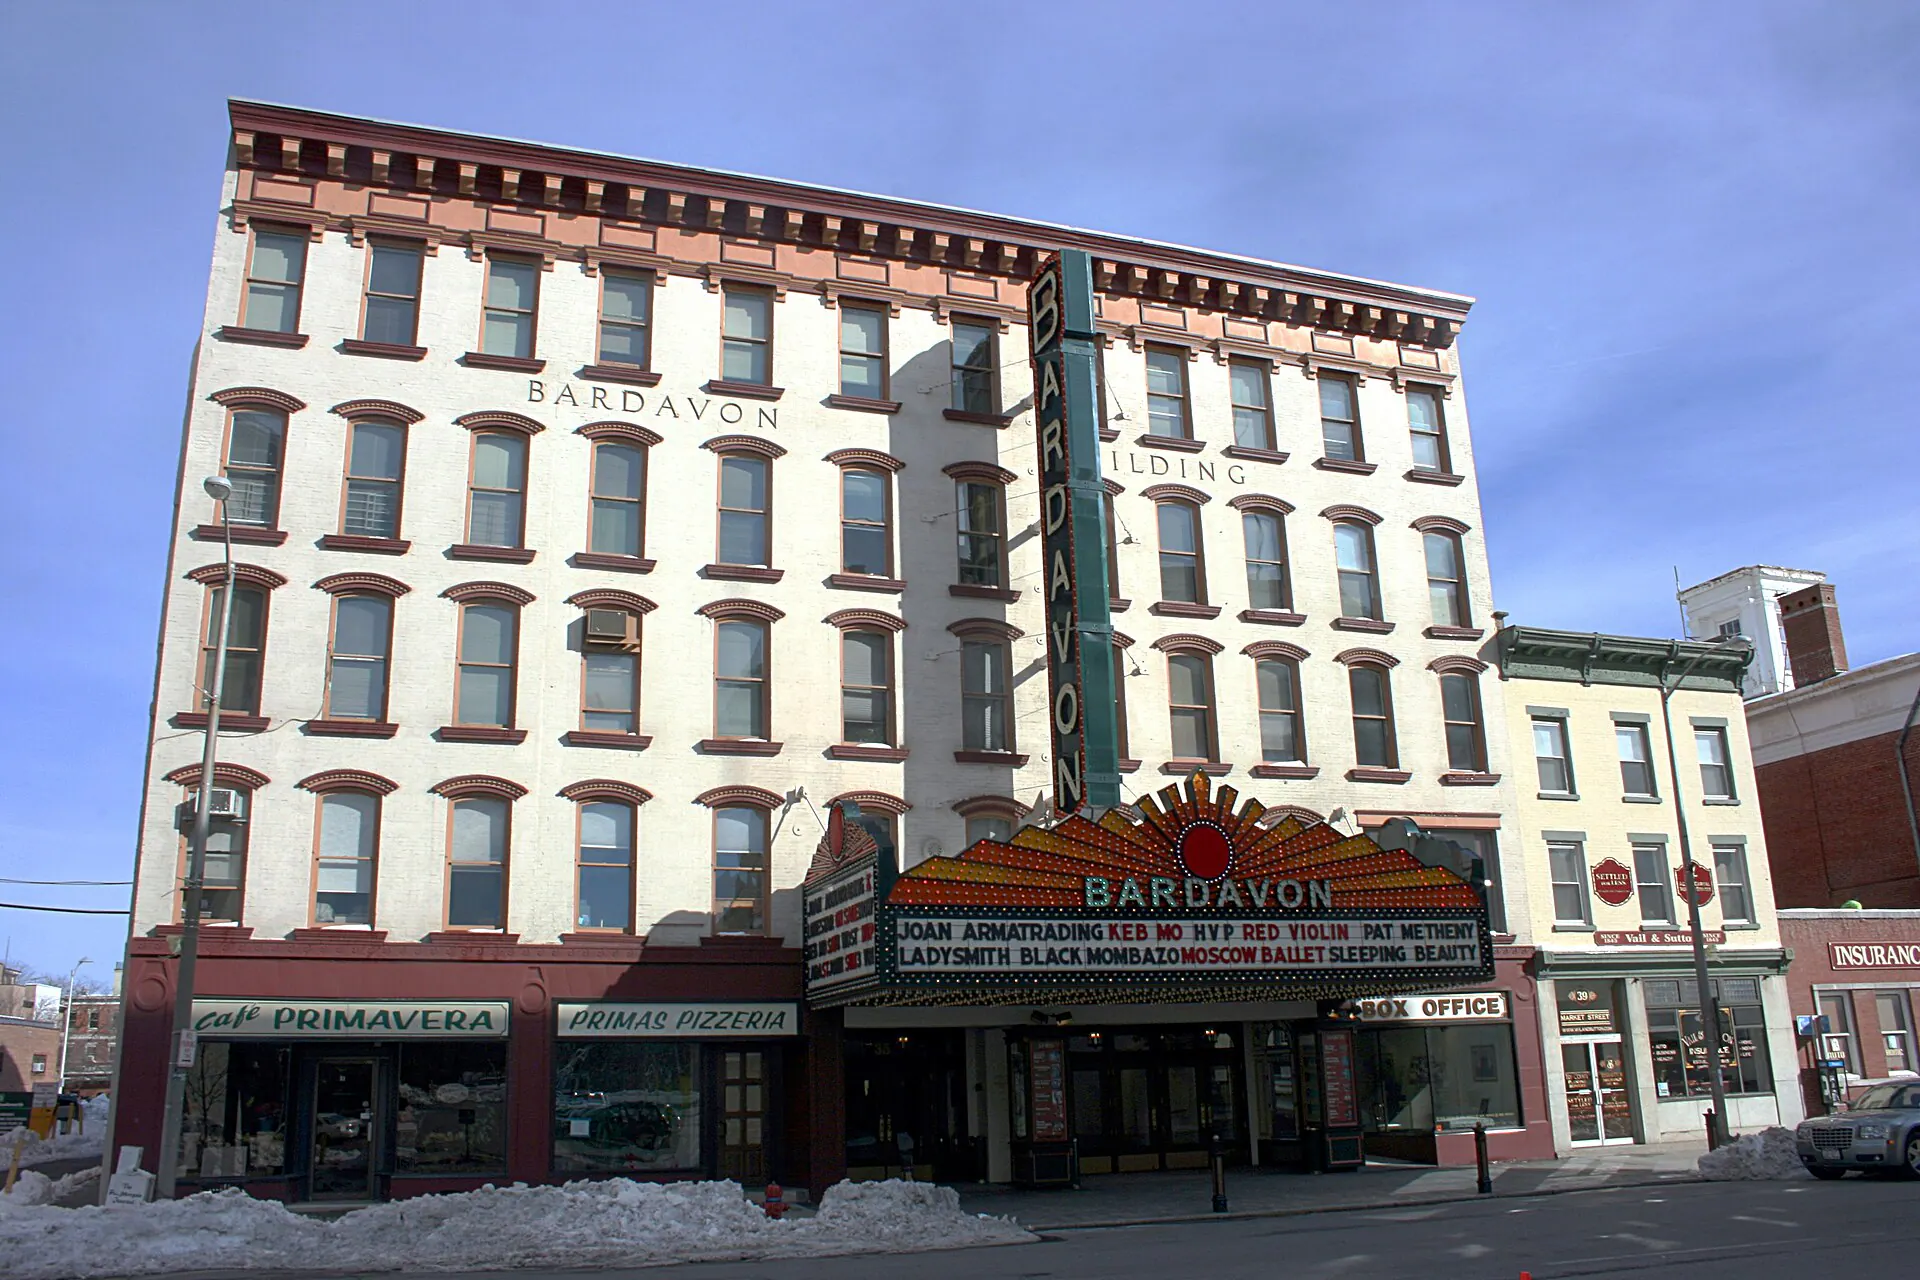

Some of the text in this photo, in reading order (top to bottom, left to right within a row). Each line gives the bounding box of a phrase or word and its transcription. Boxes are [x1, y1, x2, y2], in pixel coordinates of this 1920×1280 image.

[528, 379, 1246, 485] BARDAVON ILDING
[1031, 270, 1082, 808] BARDAVON
[1085, 876, 1333, 908] BARDAVON
[899, 922, 952, 941] JOAN
[963, 922, 1103, 941] ARMATRADING
[1108, 922, 1149, 941] KEB
[1156, 922, 1183, 941] MO
[1242, 923, 1280, 941] RED
[1289, 923, 1349, 941] VIOLIN
[1363, 923, 1394, 940] PAT
[1401, 923, 1474, 940] METHENY
[1625, 933, 1693, 943] Vail & Sutto
[900, 944, 1477, 965] LADYSMITH BLACK MOMBAZO MOSCOW BALLET SLEEPING BEAUTY
[1576, 991, 1588, 1001] 39
[1362, 998, 1500, 1018] BOX OFFICE
[273, 1007, 494, 1031] PRIMAVERA
[569, 1010, 787, 1031] PRIMAS PIZZERIA
